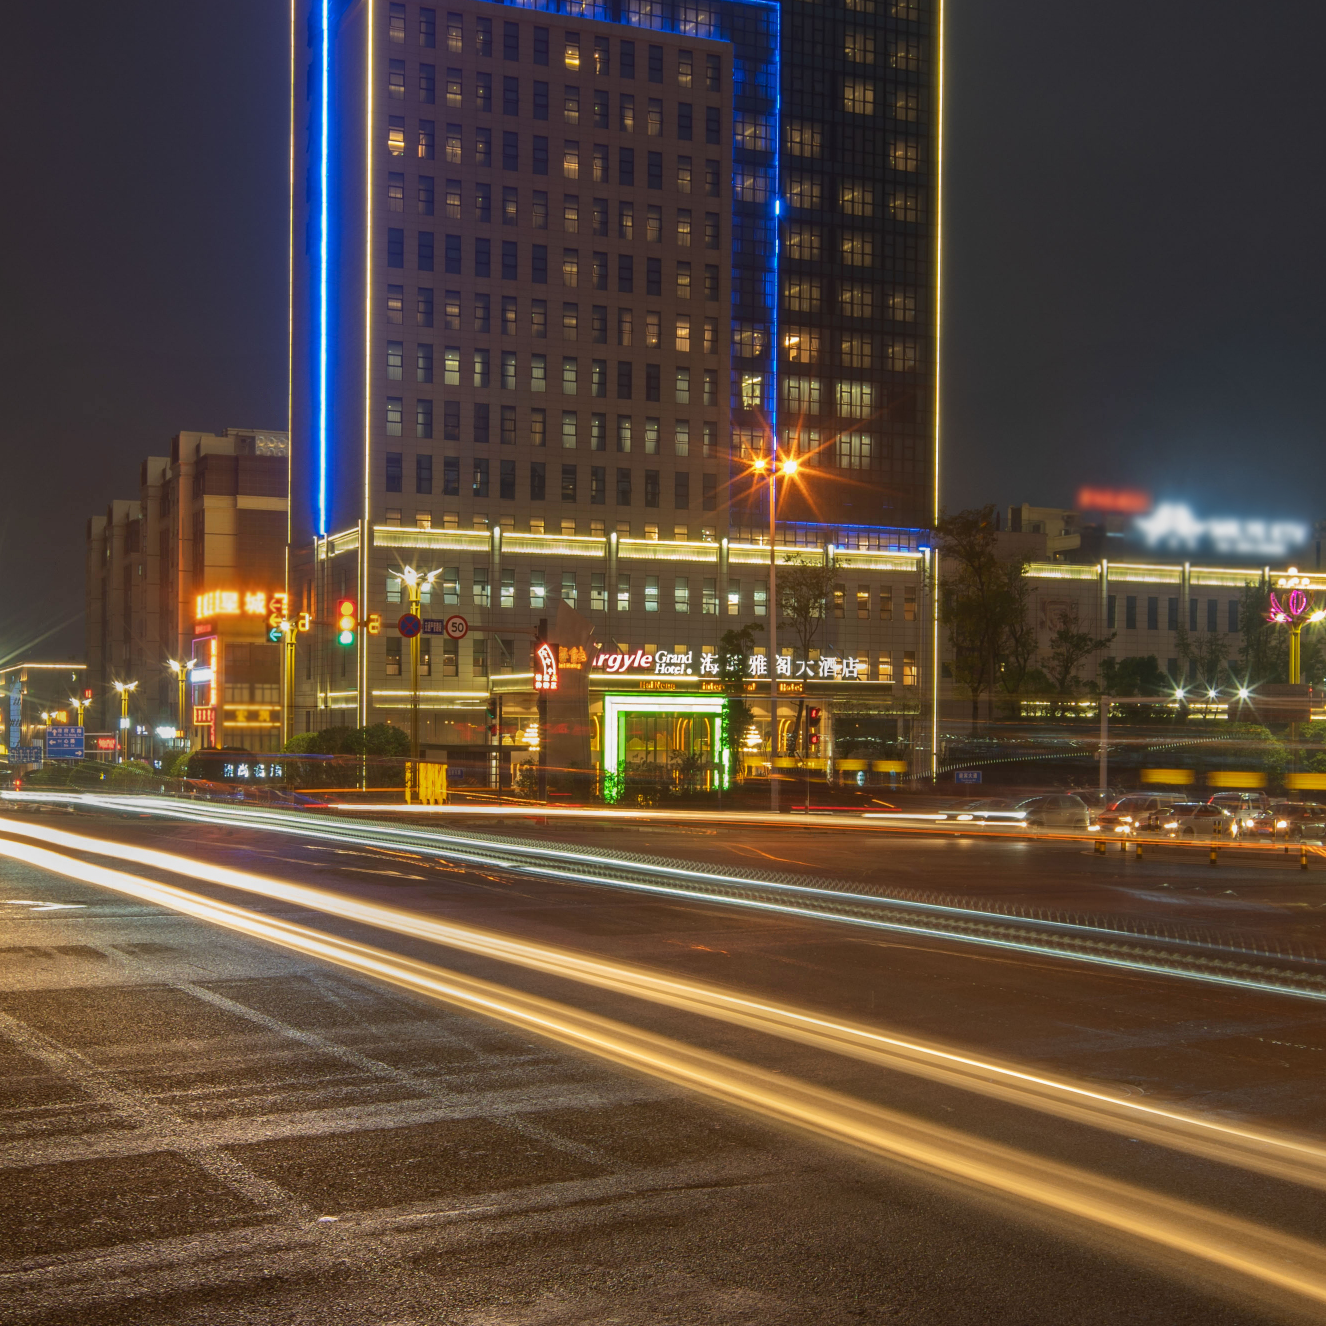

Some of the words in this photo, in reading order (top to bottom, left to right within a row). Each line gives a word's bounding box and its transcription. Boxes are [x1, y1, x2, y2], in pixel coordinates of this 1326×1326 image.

[451, 622, 464, 633] 50
[655, 650, 693, 664] Grand
[654, 663, 685, 675] Hotel
